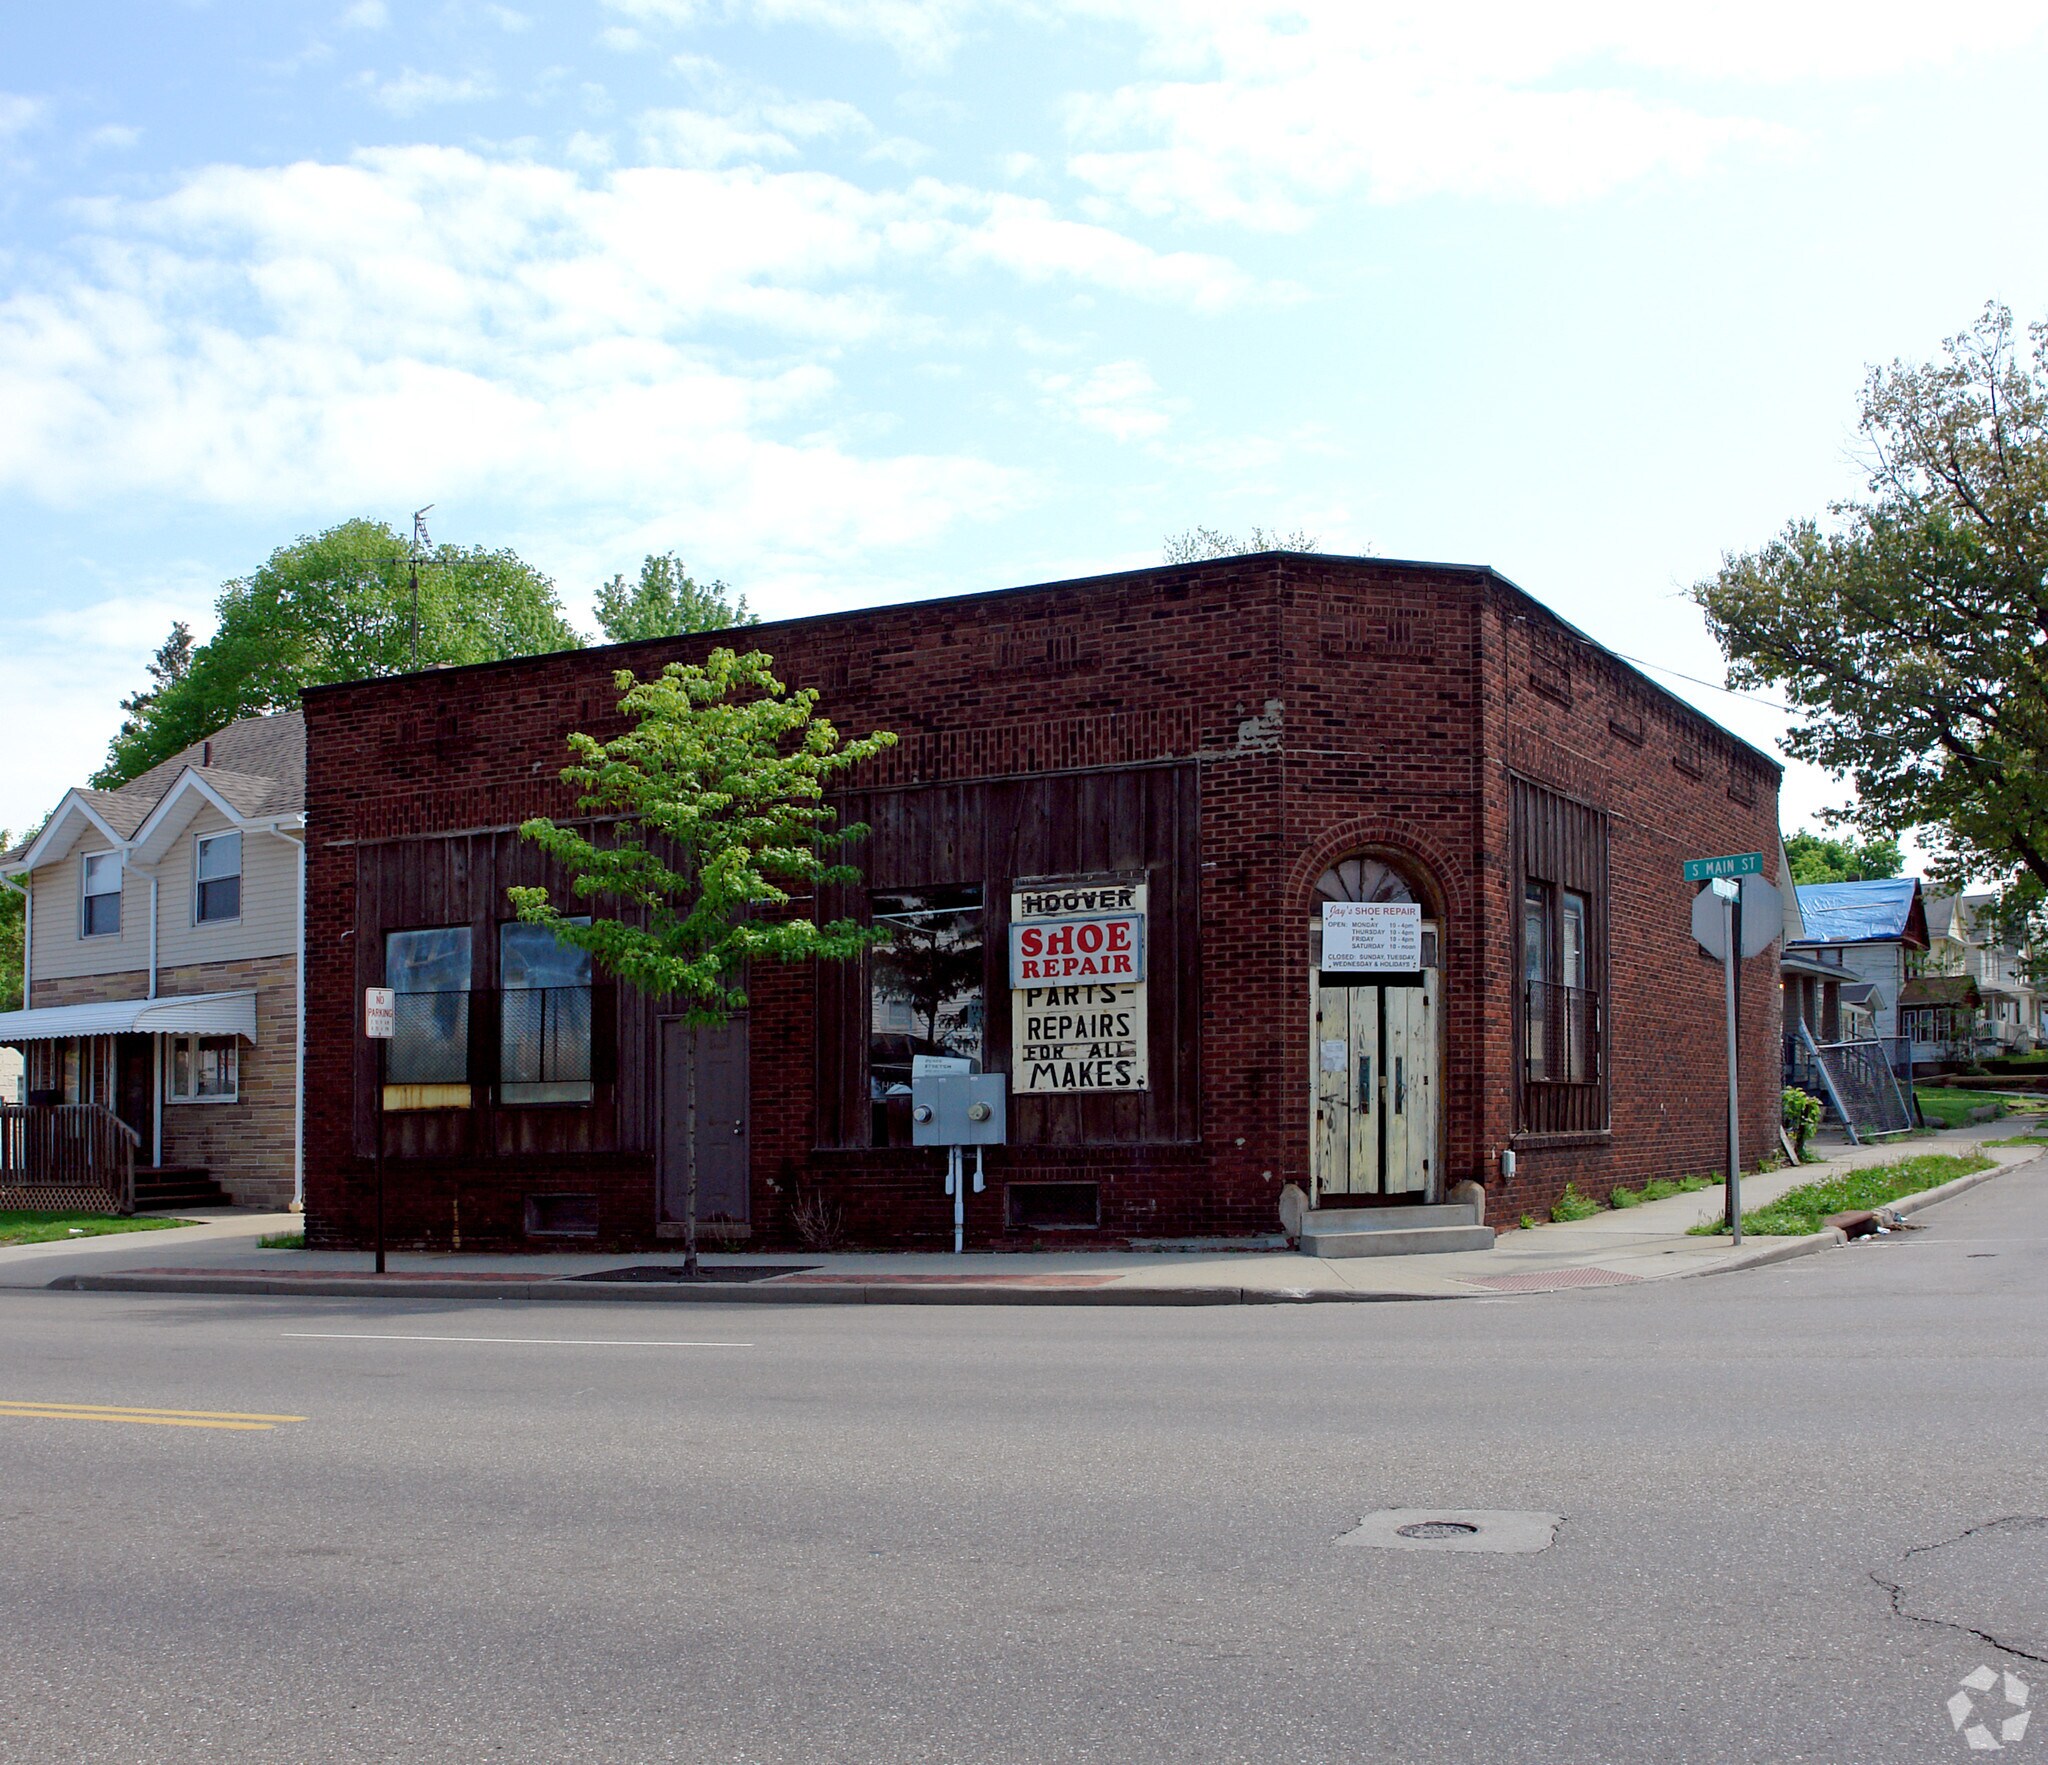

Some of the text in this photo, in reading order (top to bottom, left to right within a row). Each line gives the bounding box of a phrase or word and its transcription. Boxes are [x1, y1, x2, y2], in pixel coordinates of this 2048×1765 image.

[1692, 857, 1755, 876] S MAIN ST
[1026, 889, 1132, 914] HOOVER
[1328, 905, 1416, 918] Jay's SHOE REPAIR
[1021, 921, 1132, 957] SHOE
[1021, 955, 1133, 979] REPAIR
[376, 996, 384, 1004] NO
[368, 1008, 393, 1017] PARKING
[1027, 1012, 1131, 1041] REPAIRS
[1029, 1060, 1132, 1089] MAKES
